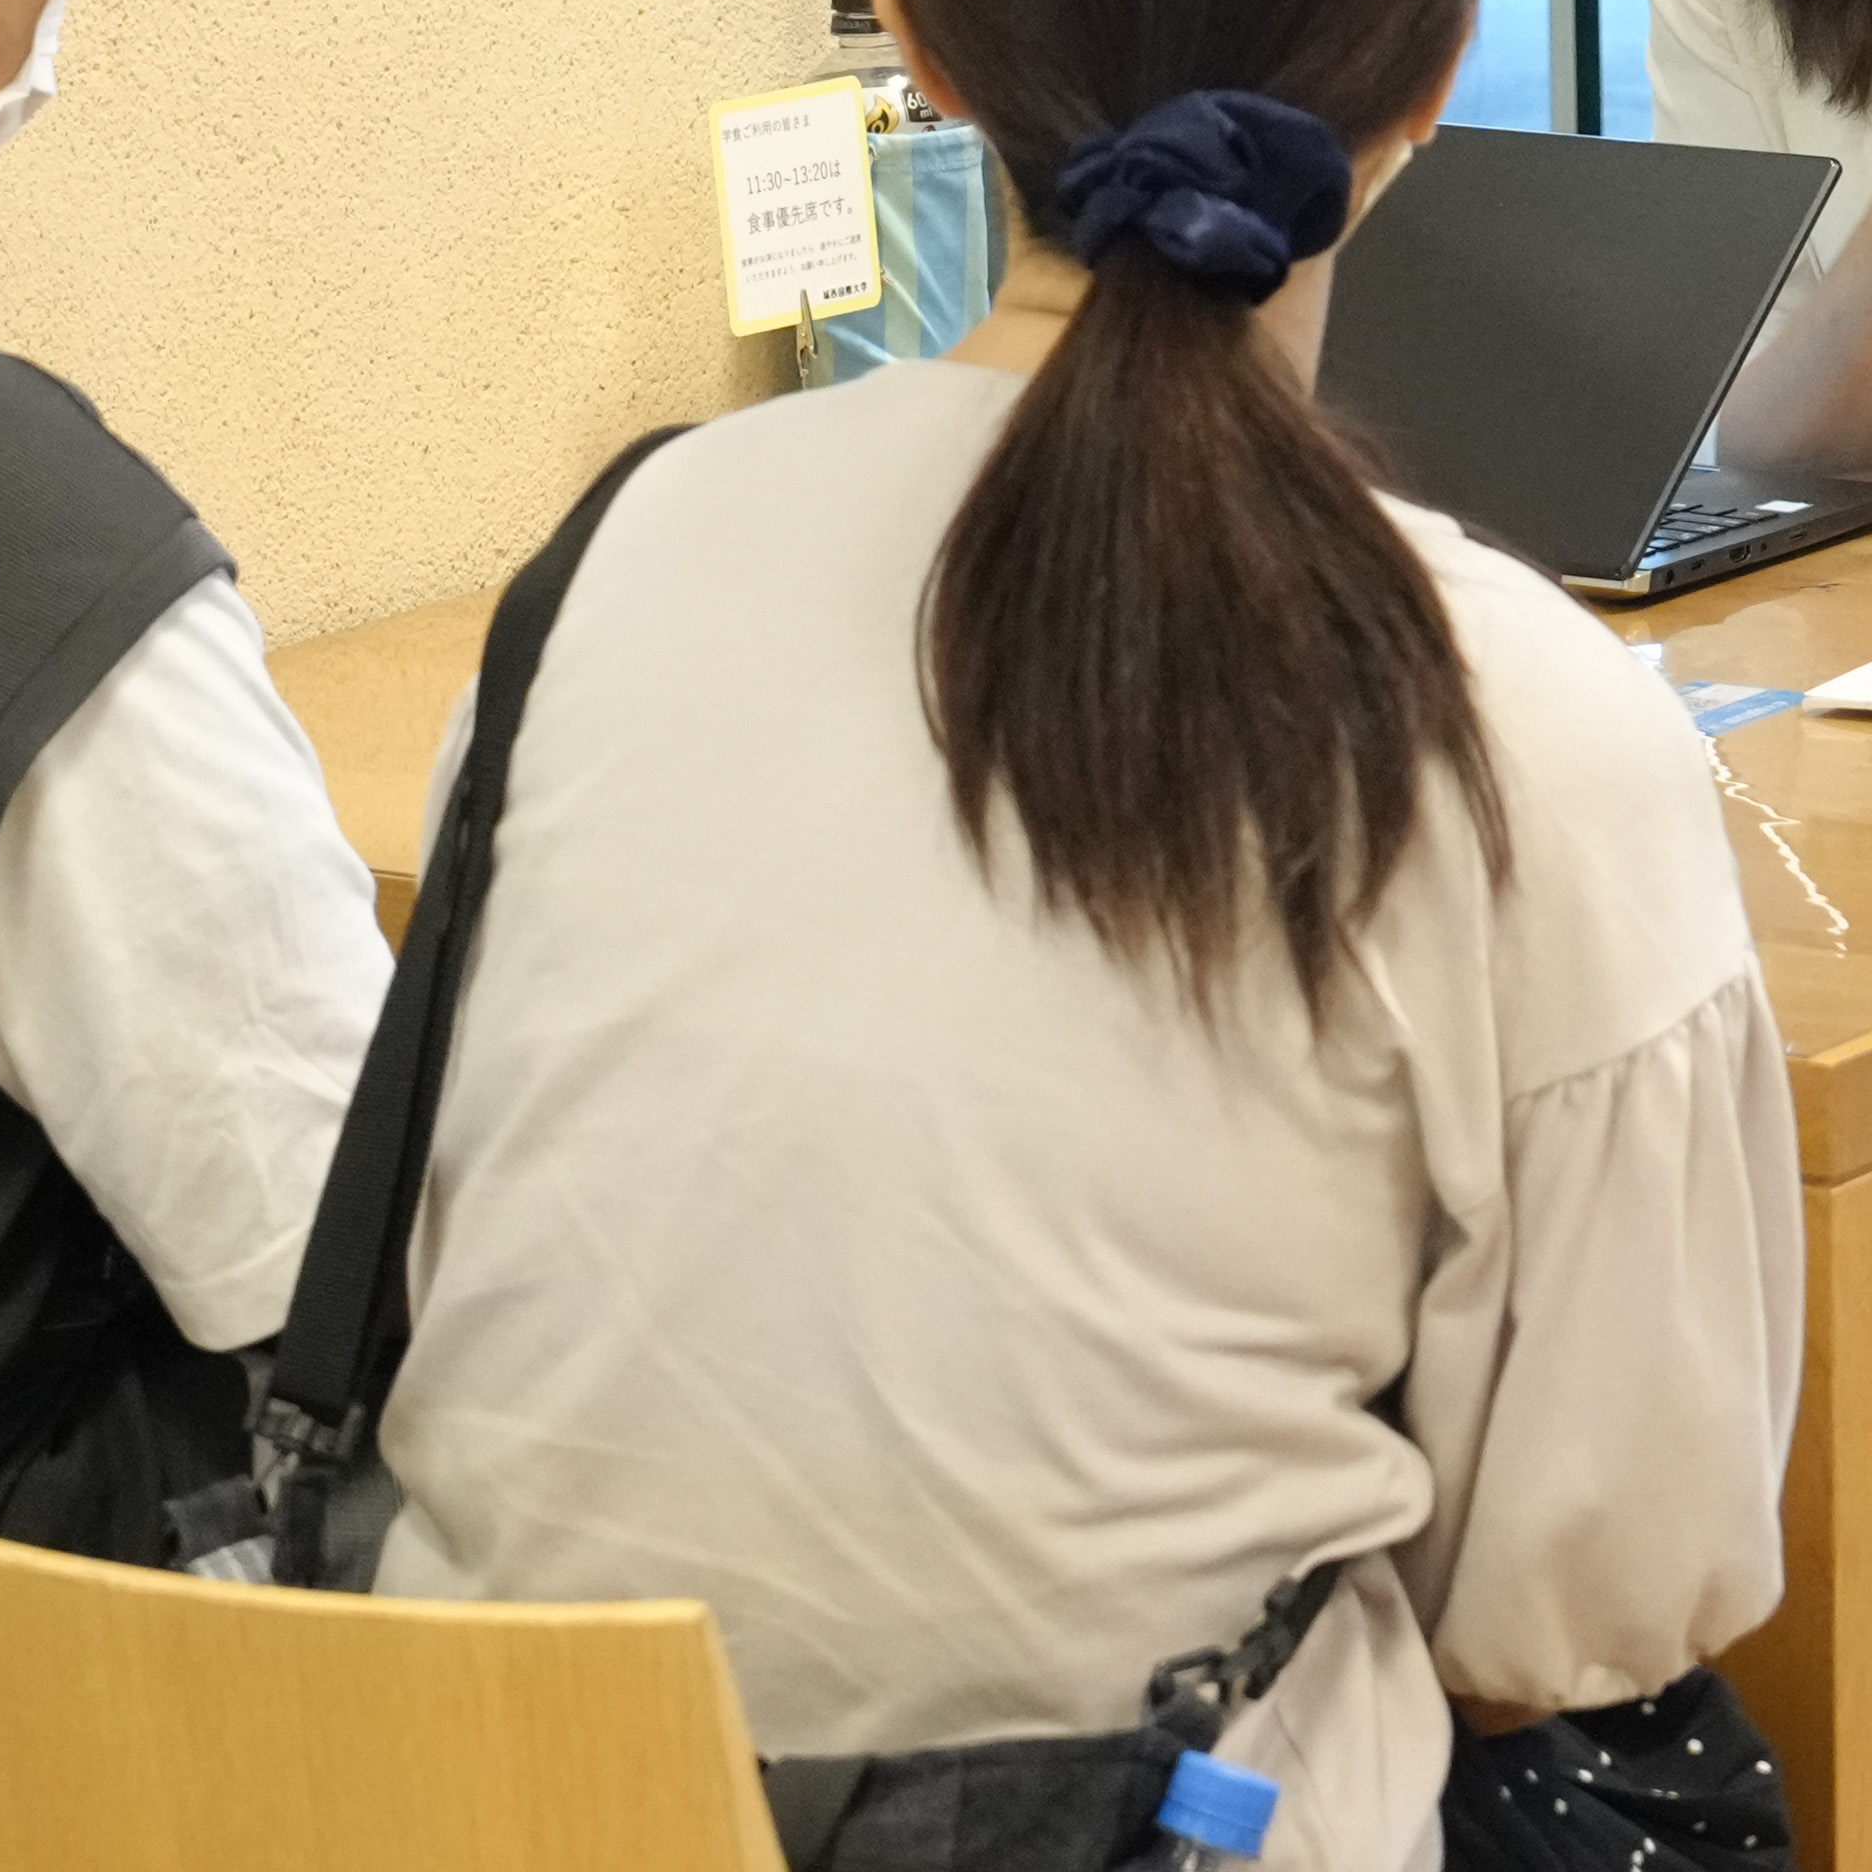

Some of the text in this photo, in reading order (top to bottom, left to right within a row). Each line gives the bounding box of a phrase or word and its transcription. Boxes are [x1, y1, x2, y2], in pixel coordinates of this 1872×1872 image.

[722, 113, 811, 142] 学食ご利用の皆さま
[746, 196, 853, 235] 食事優先席です。
